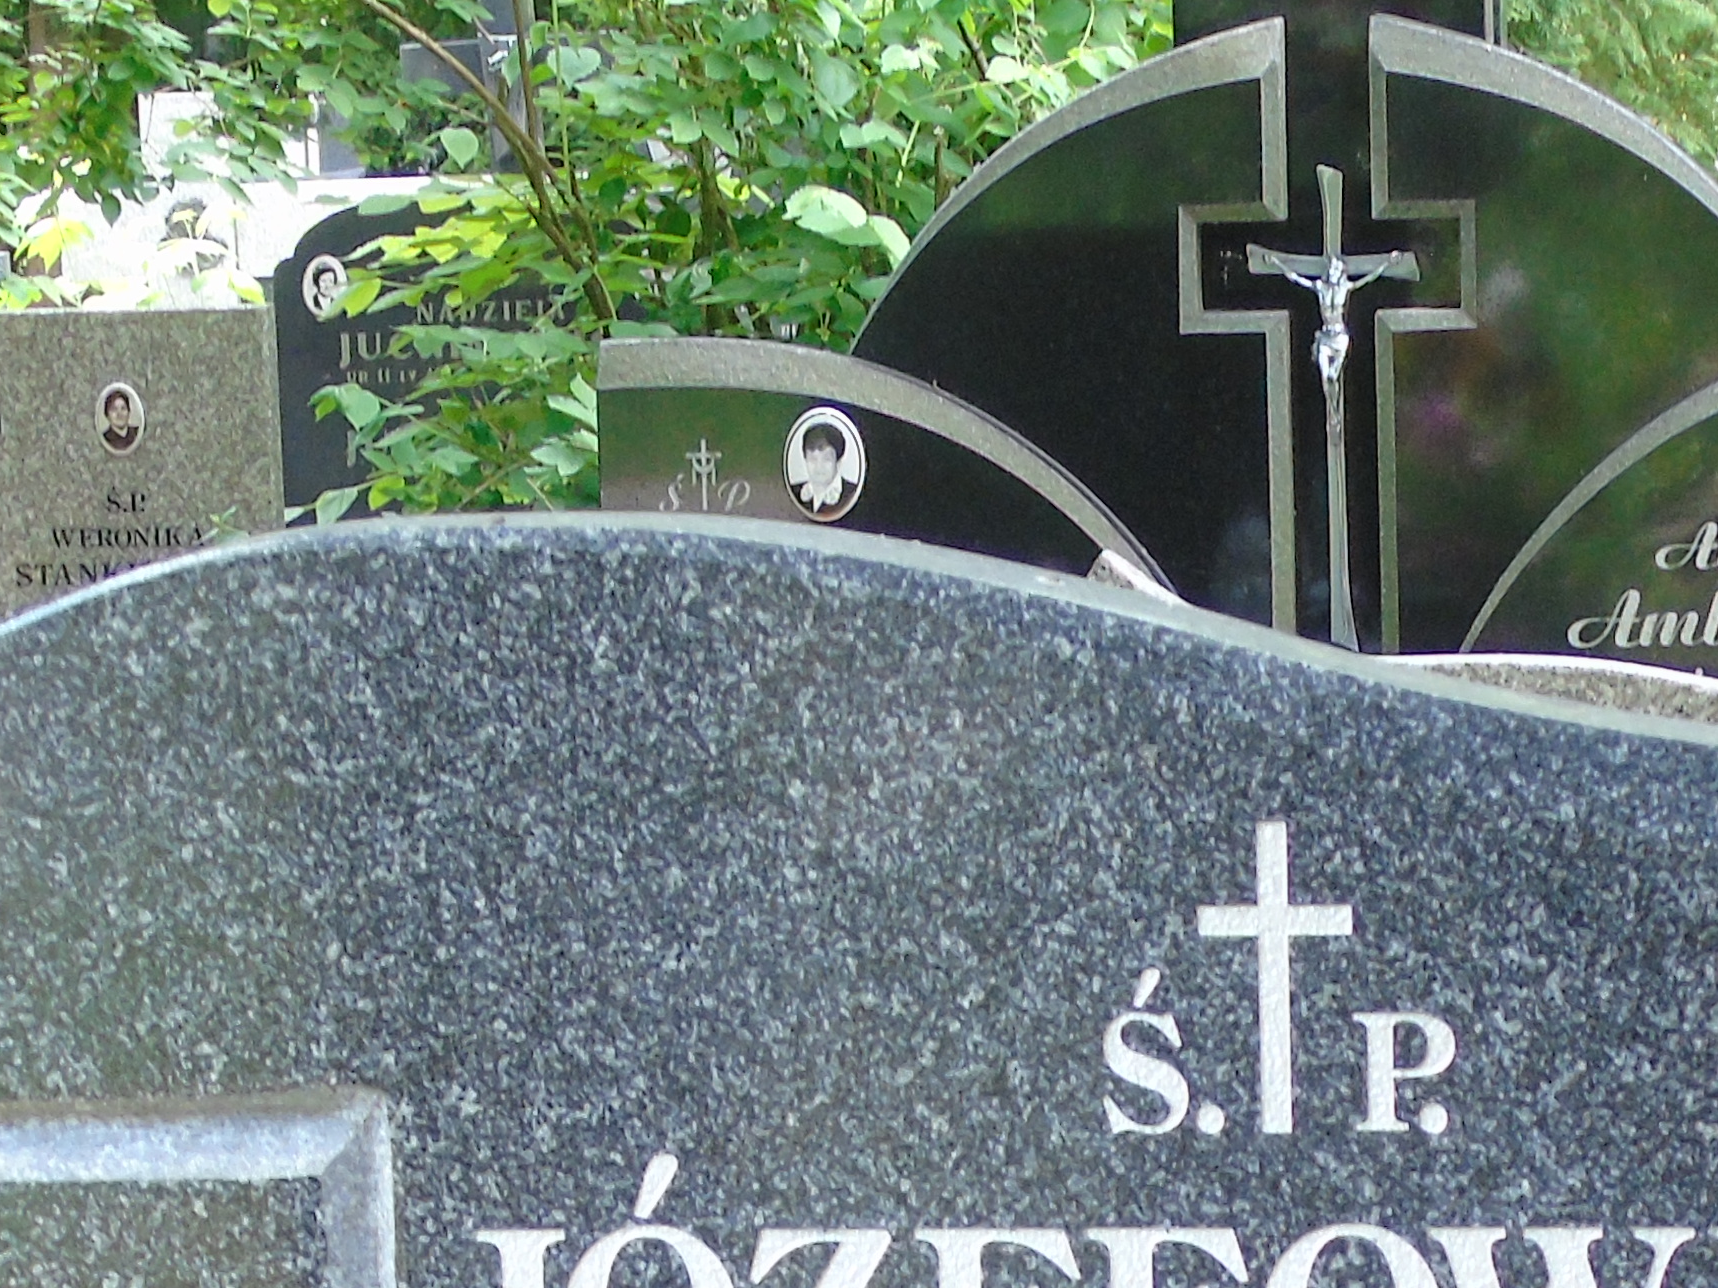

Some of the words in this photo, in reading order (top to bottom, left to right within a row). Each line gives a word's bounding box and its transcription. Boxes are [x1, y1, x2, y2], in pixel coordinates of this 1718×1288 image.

[52, 523, 206, 549] WERONIKA
[15, 560, 121, 588] STANK
[1102, 967, 1226, 1135] Ś.
[1352, 1011, 1449, 1135] P.
